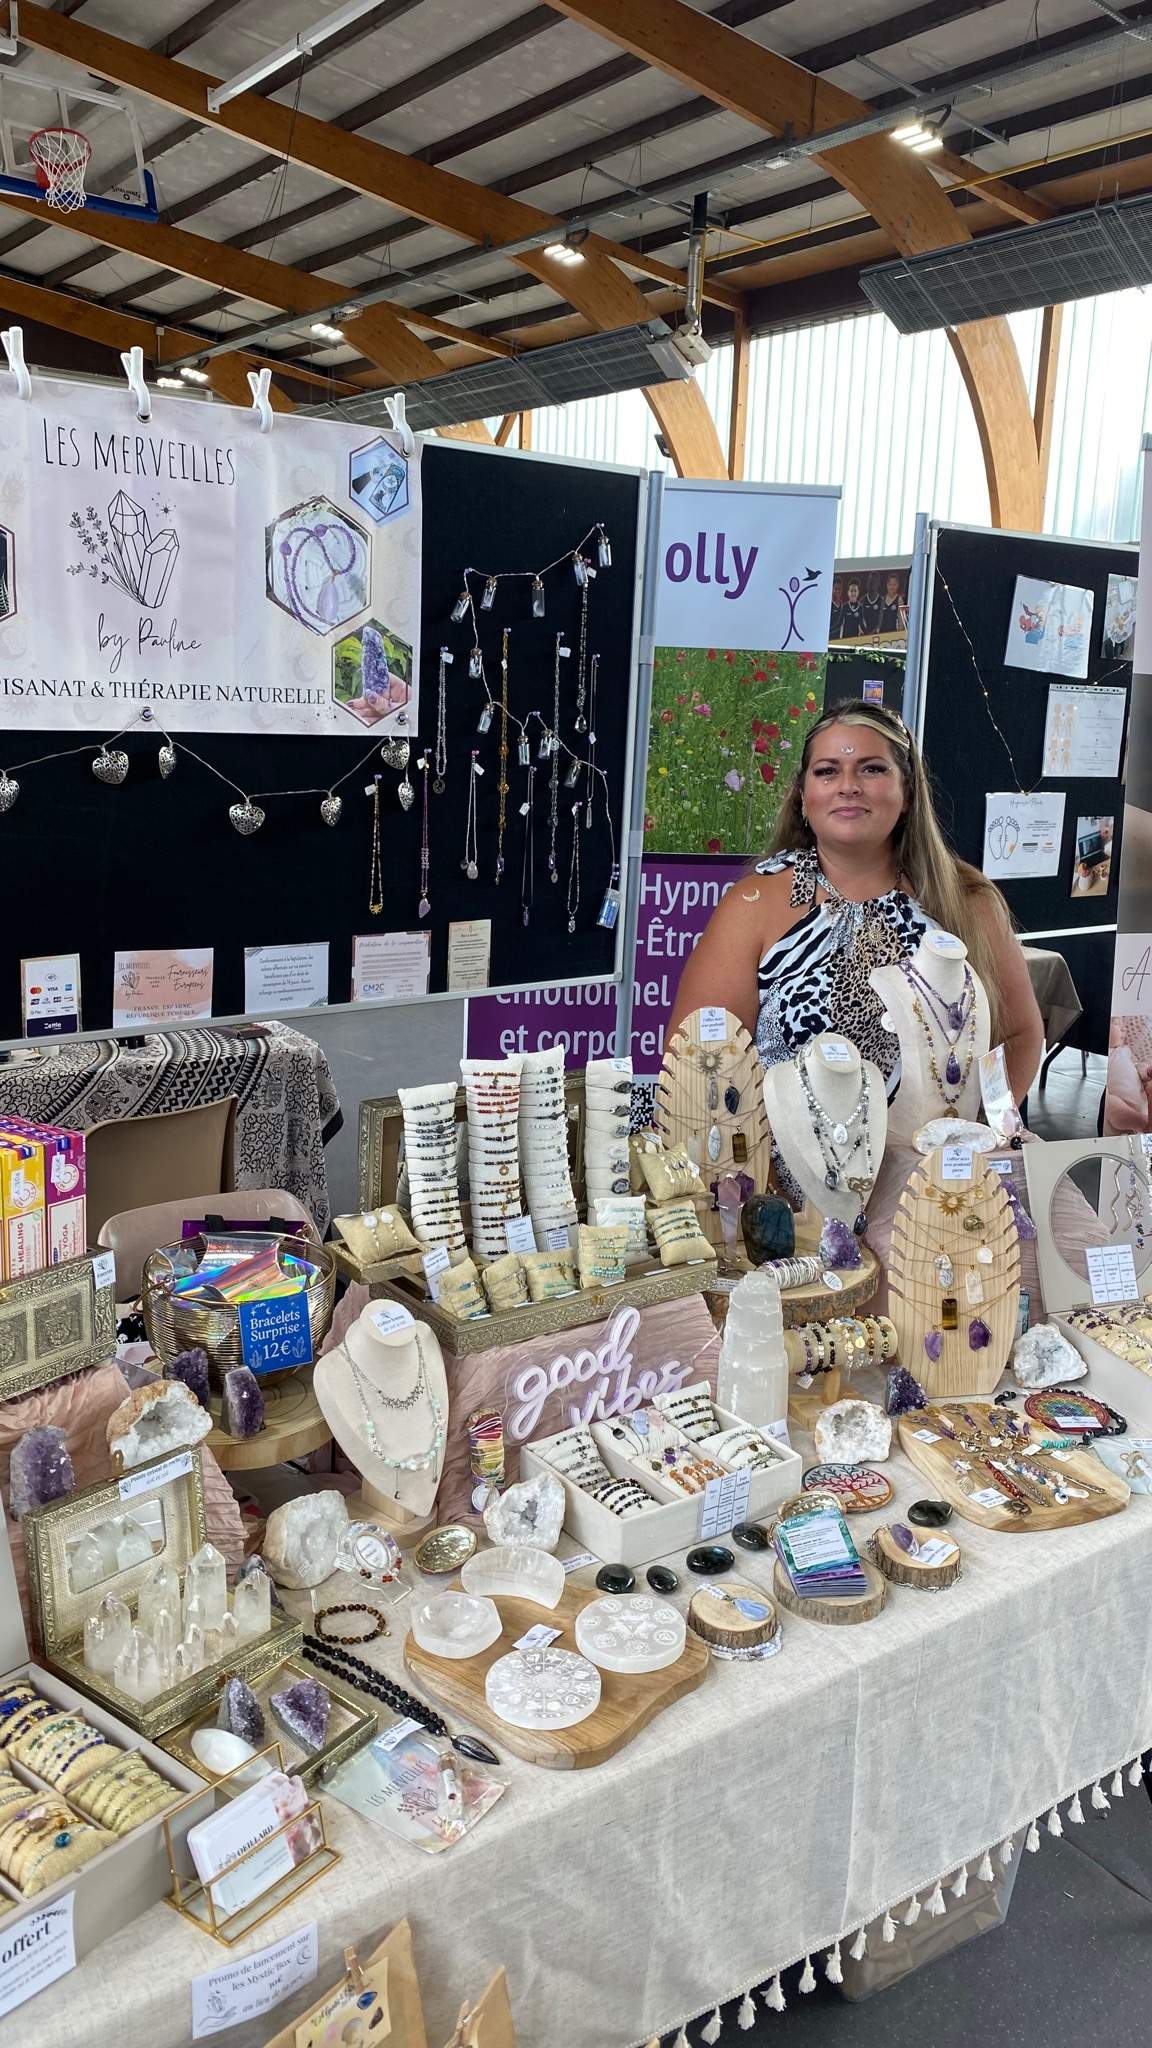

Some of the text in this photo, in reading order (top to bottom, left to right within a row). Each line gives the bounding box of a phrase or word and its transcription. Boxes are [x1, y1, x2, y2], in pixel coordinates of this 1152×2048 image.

[43, 418, 235, 486] LES MERVEILLES
[665, 532, 759, 599] olly
[98, 612, 202, 673] by Pauline
[0, 678, 326, 705] ISANAT & THÉRAPIE NATURELLE
[499, 1024, 529, 1054] et
[250, 1309, 300, 1330] Bracelets
[250, 1322, 300, 1342] Surprise
[262, 1340, 291, 1360] 12€
[508, 1306, 642, 1441] good
[568, 1360, 695, 1426] vibes
[2, 1922, 50, 1963] offert
[208, 1933, 310, 1987] Promo de lancement sur
[231, 1980, 245, 1991] les
[246, 1966, 275, 1988] Mystic
[276, 1958, 292, 1971] Box
